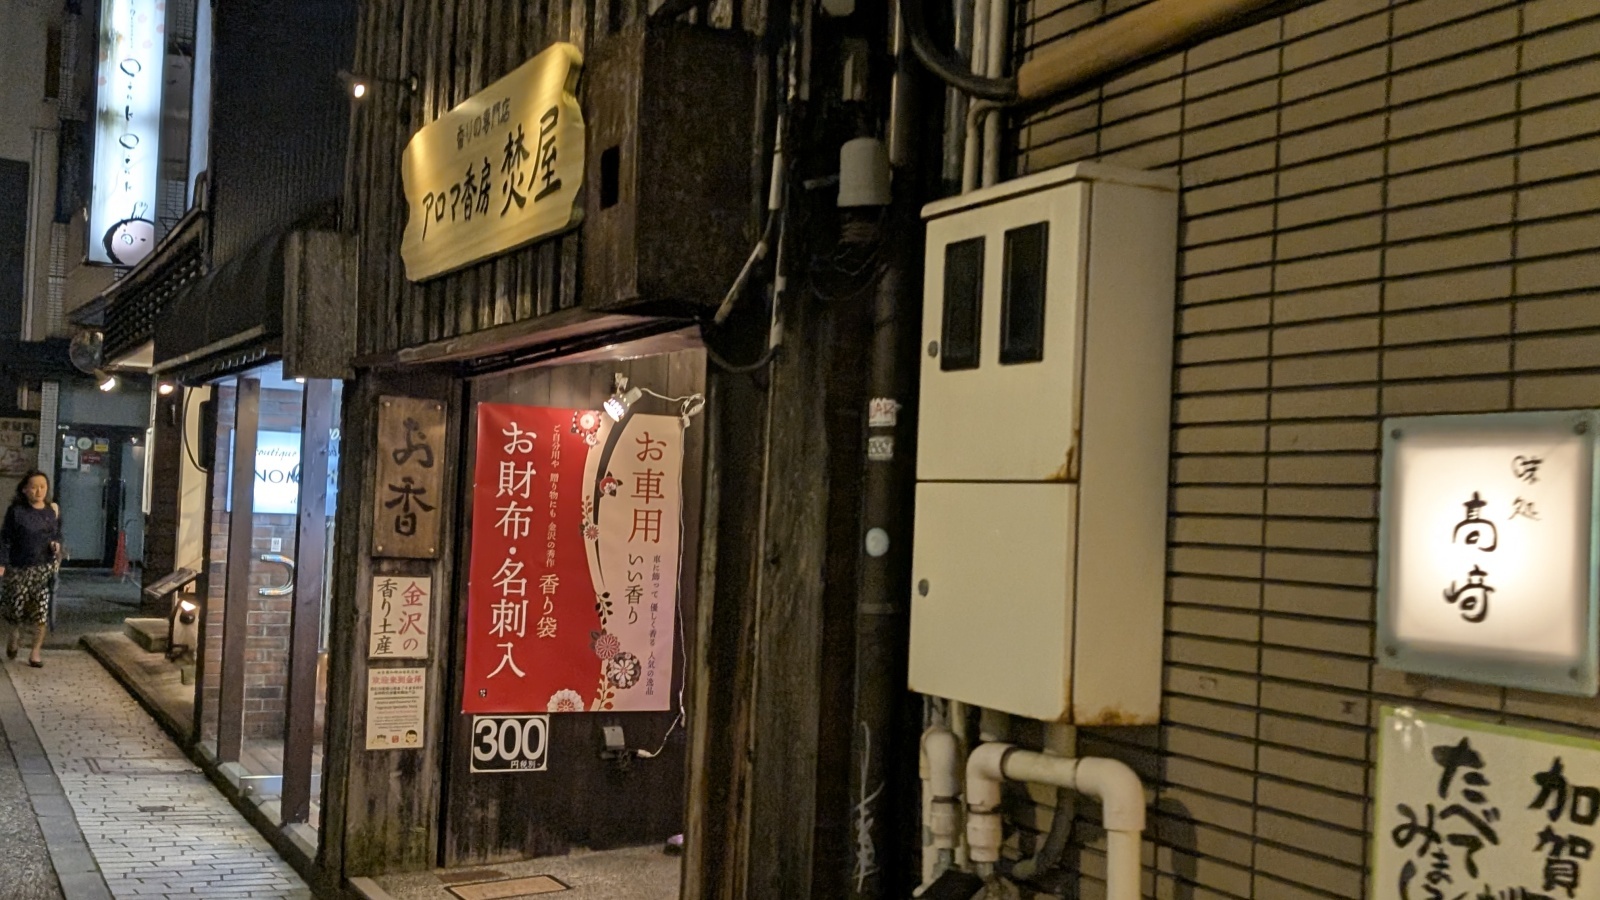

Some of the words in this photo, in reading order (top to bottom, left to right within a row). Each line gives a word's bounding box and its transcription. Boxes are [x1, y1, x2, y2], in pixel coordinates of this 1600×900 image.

[456, 97, 511, 150] 香りの専門店
[421, 156, 492, 242] アロマ香房
[500, 106, 562, 217] 焚屋
[383, 416, 436, 537] お香
[627, 431, 668, 545] お車用
[486, 421, 537, 679] お財布・名刺入
[624, 553, 644, 625] いい香り
[374, 577, 399, 656] 香り土産
[398, 580, 428, 653] 金沢の
[536, 573, 560, 639] 香り袋
[473, 718, 546, 761] 300
[1527, 756, 1600, 898] 加賀
